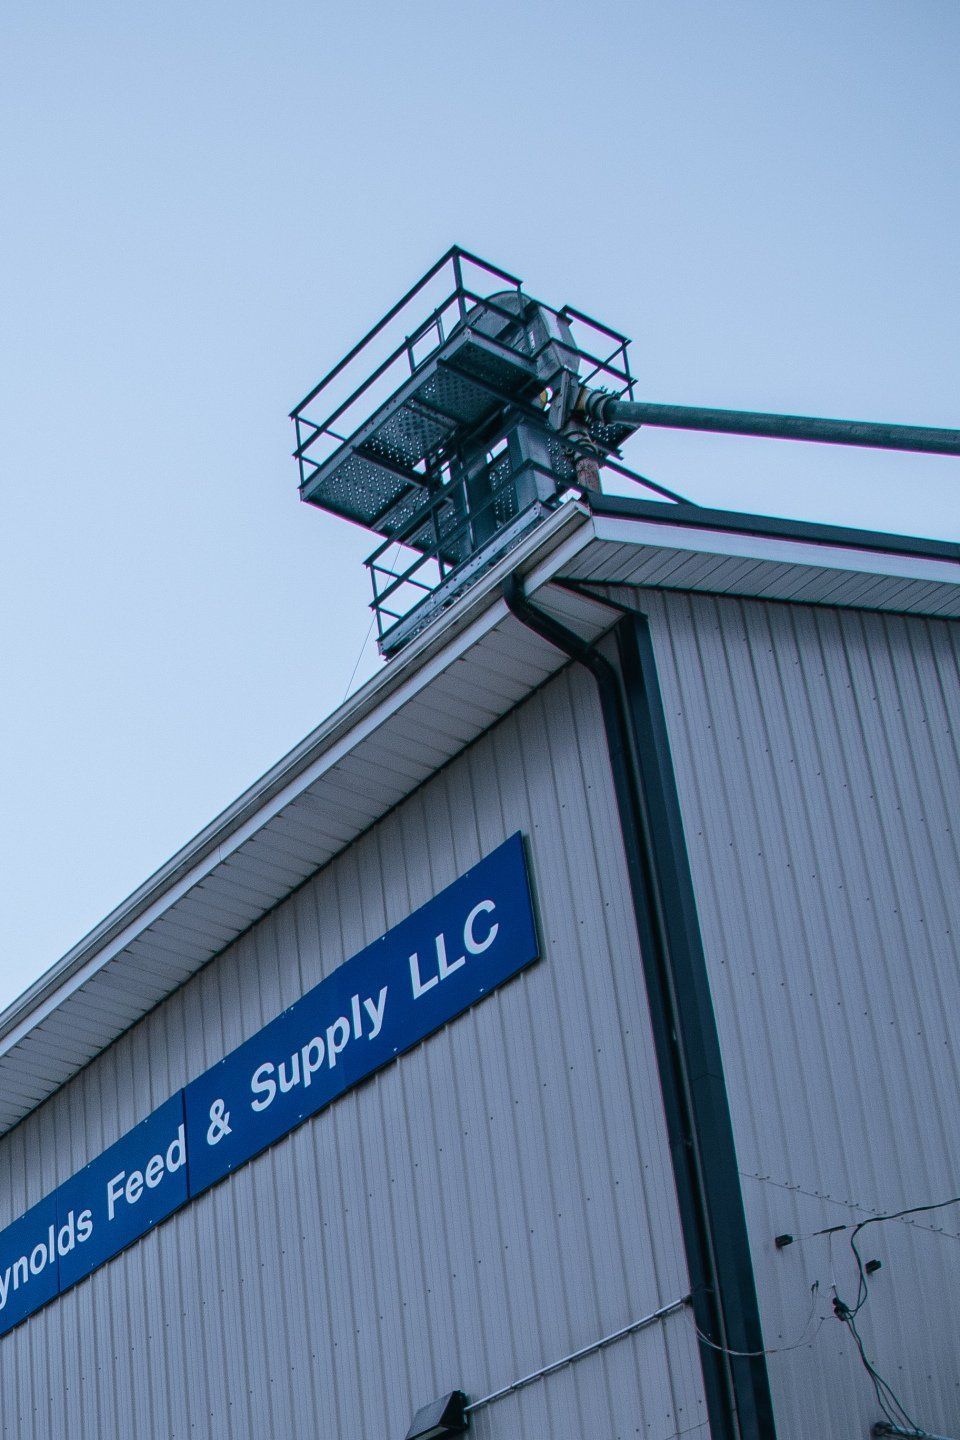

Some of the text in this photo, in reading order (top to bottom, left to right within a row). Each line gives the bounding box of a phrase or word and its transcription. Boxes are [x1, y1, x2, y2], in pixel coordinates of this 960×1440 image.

[108, 1124, 187, 1220] Feed
[207, 1099, 232, 1146] &
[251, 986, 388, 1112] Supply
[409, 900, 499, 999] LLC
